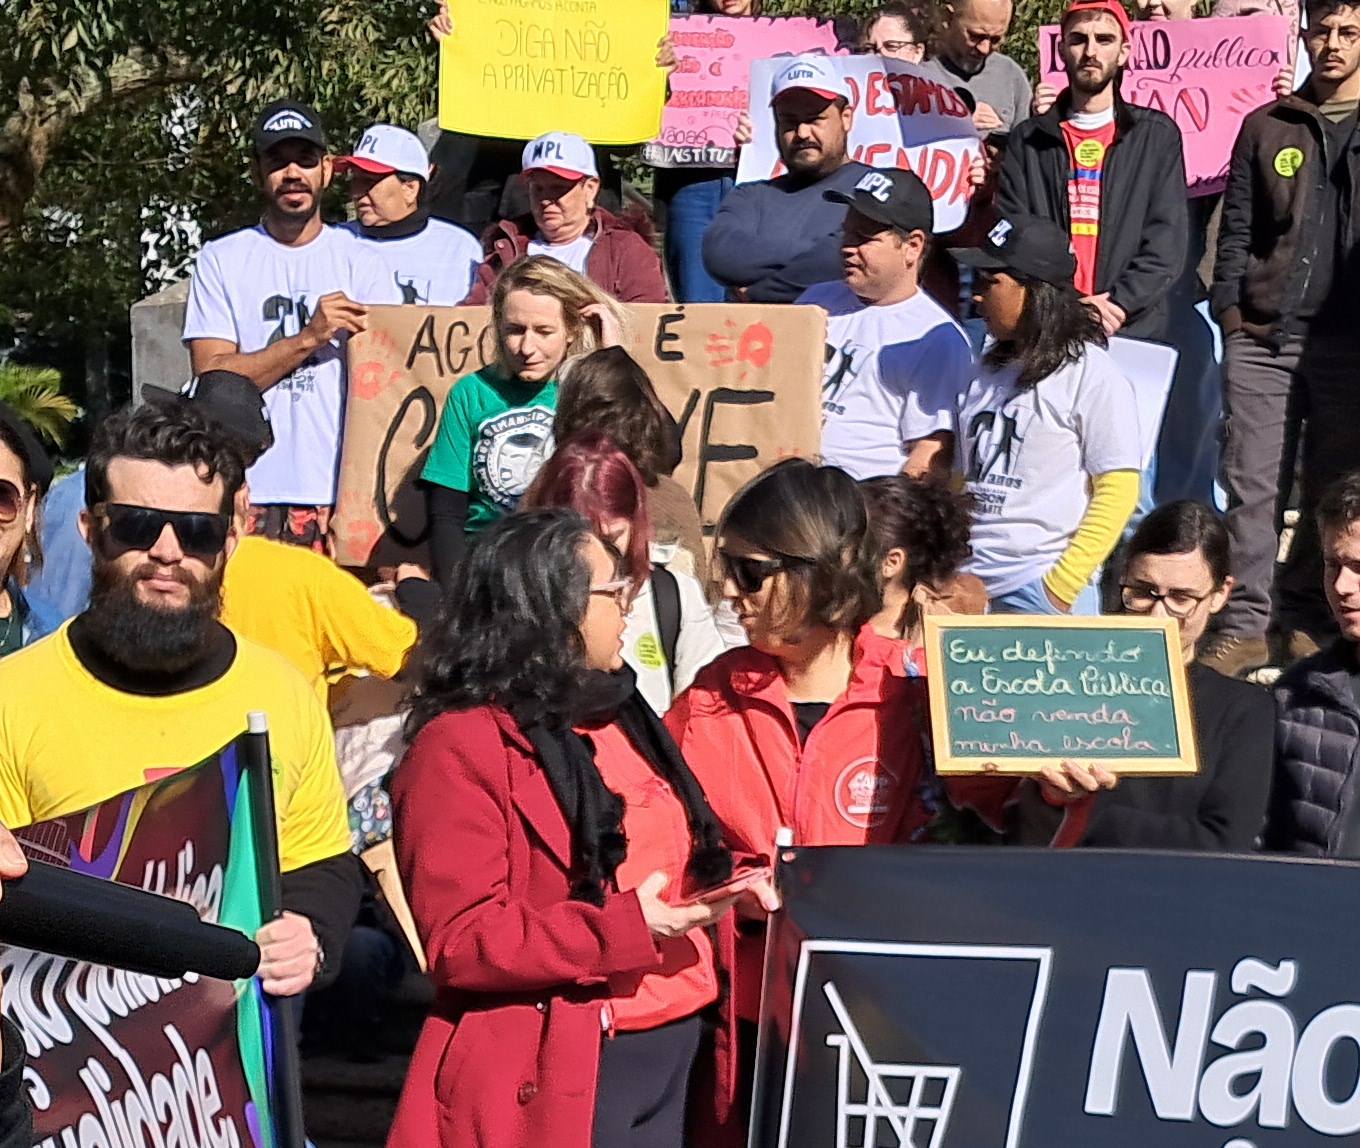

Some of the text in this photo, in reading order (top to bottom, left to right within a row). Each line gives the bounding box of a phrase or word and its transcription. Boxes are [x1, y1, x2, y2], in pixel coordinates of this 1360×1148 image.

[564, 20, 610, 63] NÃO
[483, 63, 628, 107] A PRIVATIZAÇÃO
[854, 143, 976, 205] NDA
[654, 306, 686, 362] É
[949, 639, 996, 664] Eu
[950, 678, 976, 696] a
[981, 666, 1076, 696] Escola
[954, 699, 1140, 727] não venda
[953, 731, 1051, 754] minha
